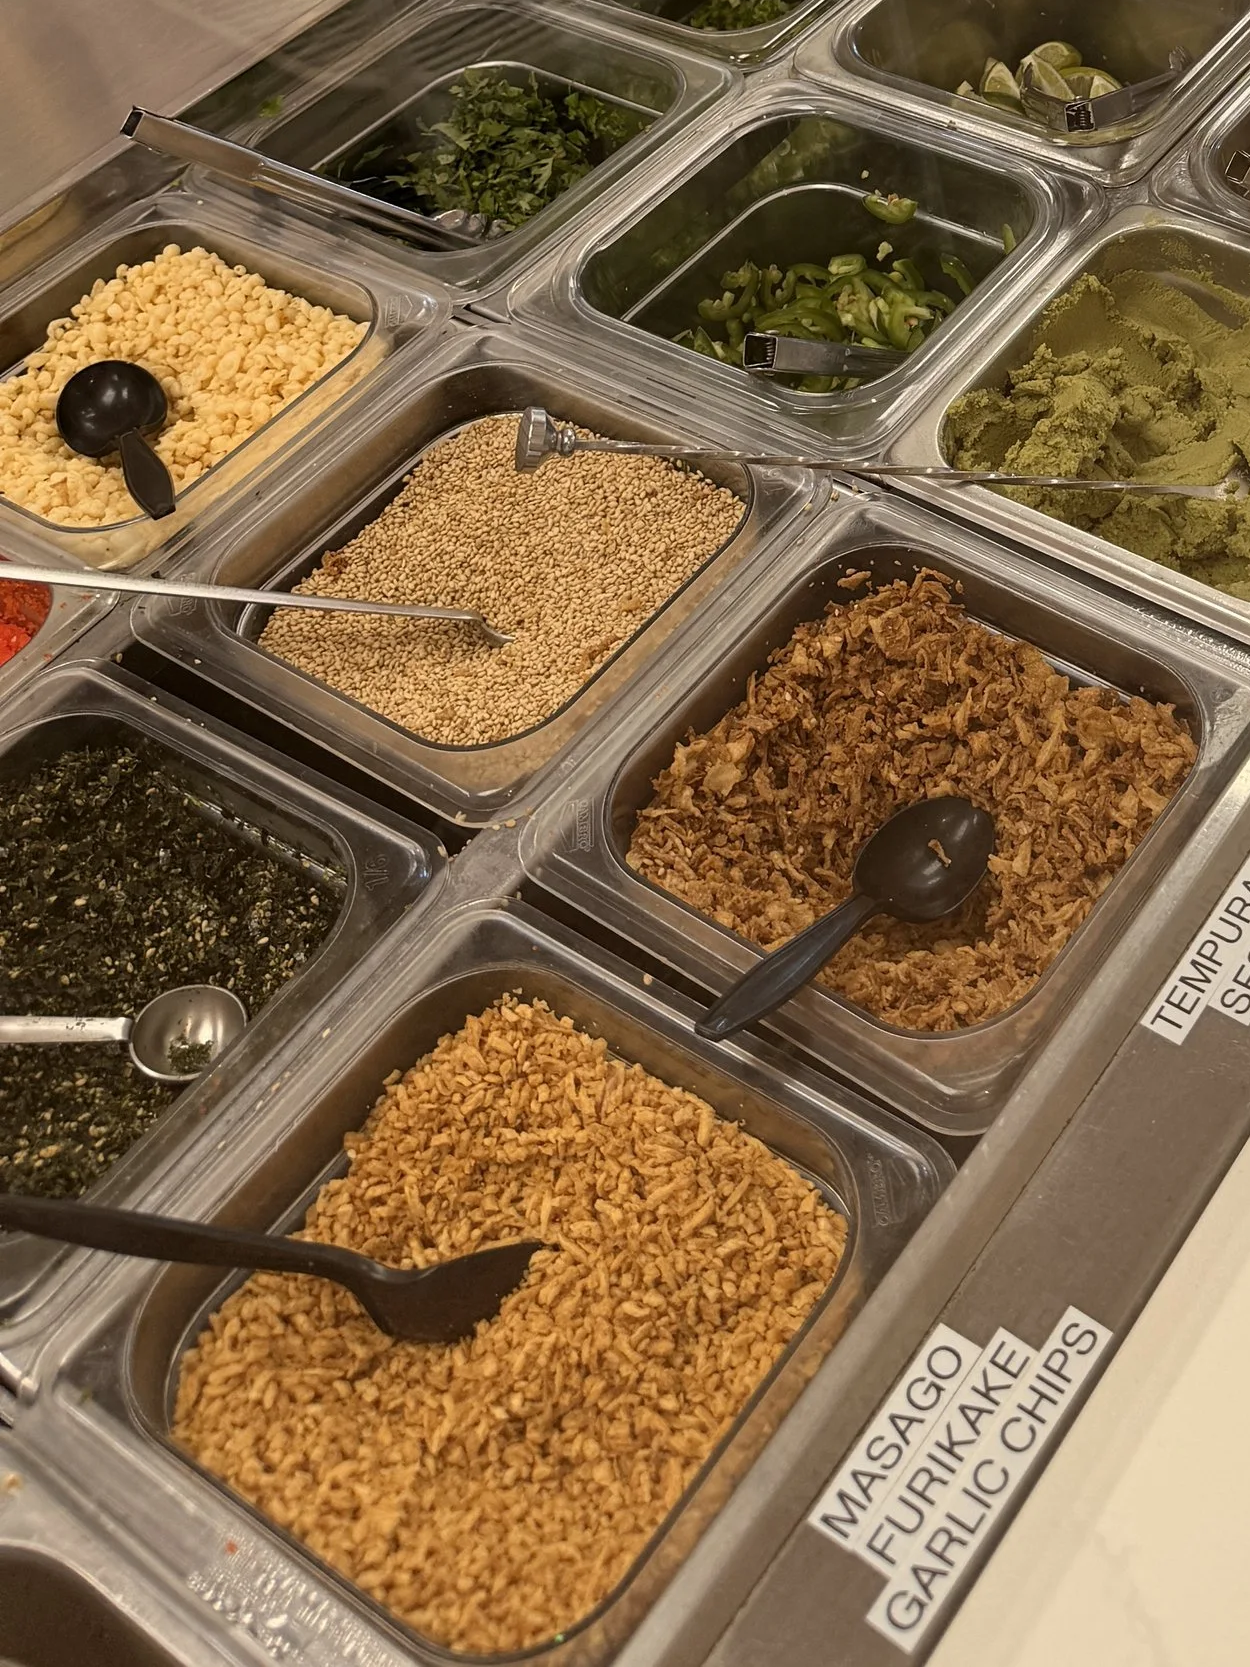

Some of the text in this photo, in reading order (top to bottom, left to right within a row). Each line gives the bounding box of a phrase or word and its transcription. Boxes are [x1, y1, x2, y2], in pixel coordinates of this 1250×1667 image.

[820, 1344, 963, 1540] MASAGO
[866, 1340, 1031, 1566] FURIKAKE
[886, 1322, 1099, 1632] GARLIC CHIPS
